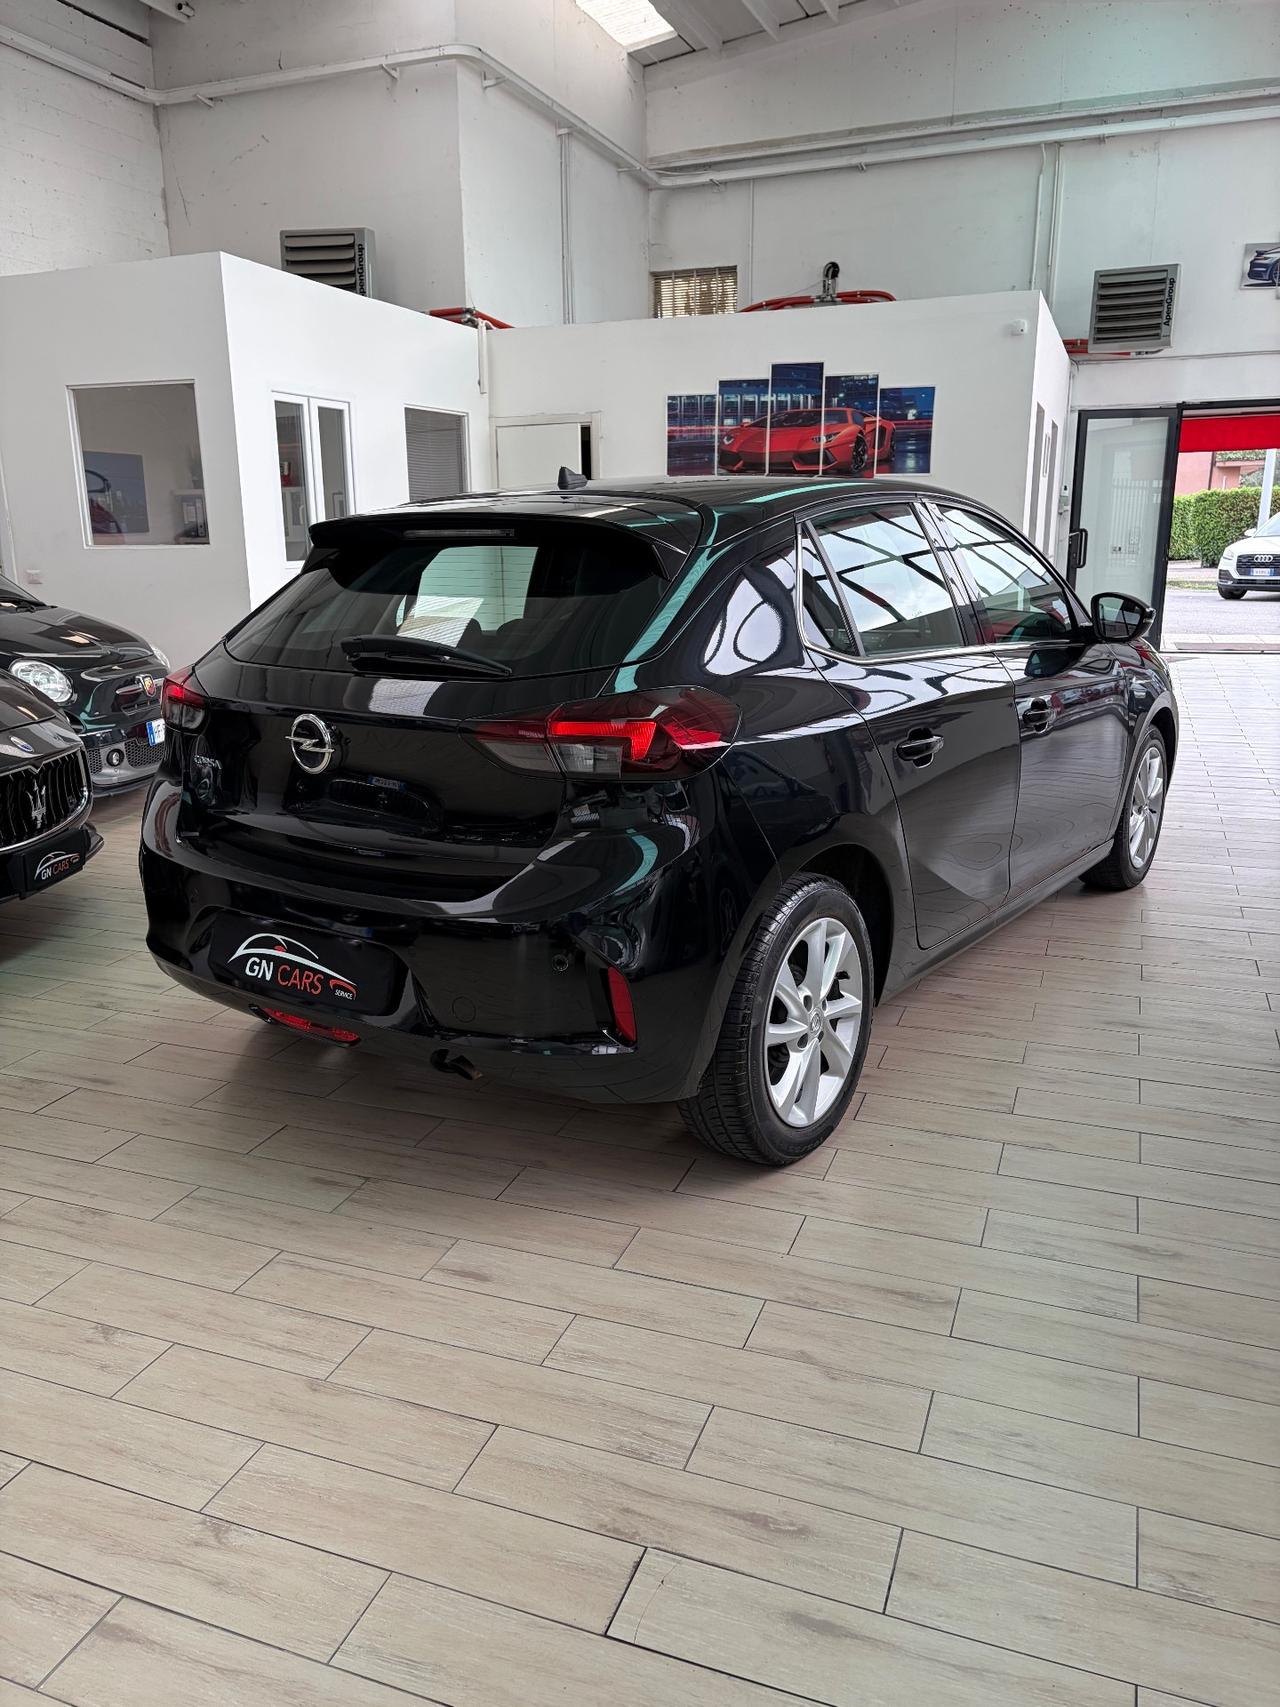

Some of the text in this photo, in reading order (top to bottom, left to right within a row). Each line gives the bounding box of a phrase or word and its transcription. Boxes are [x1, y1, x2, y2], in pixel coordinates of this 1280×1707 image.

[357, 243, 366, 296] penGroup
[1163, 277, 1176, 327] ApenGroup
[41, 867, 52, 880] GN
[245, 957, 324, 995] GN CARS
